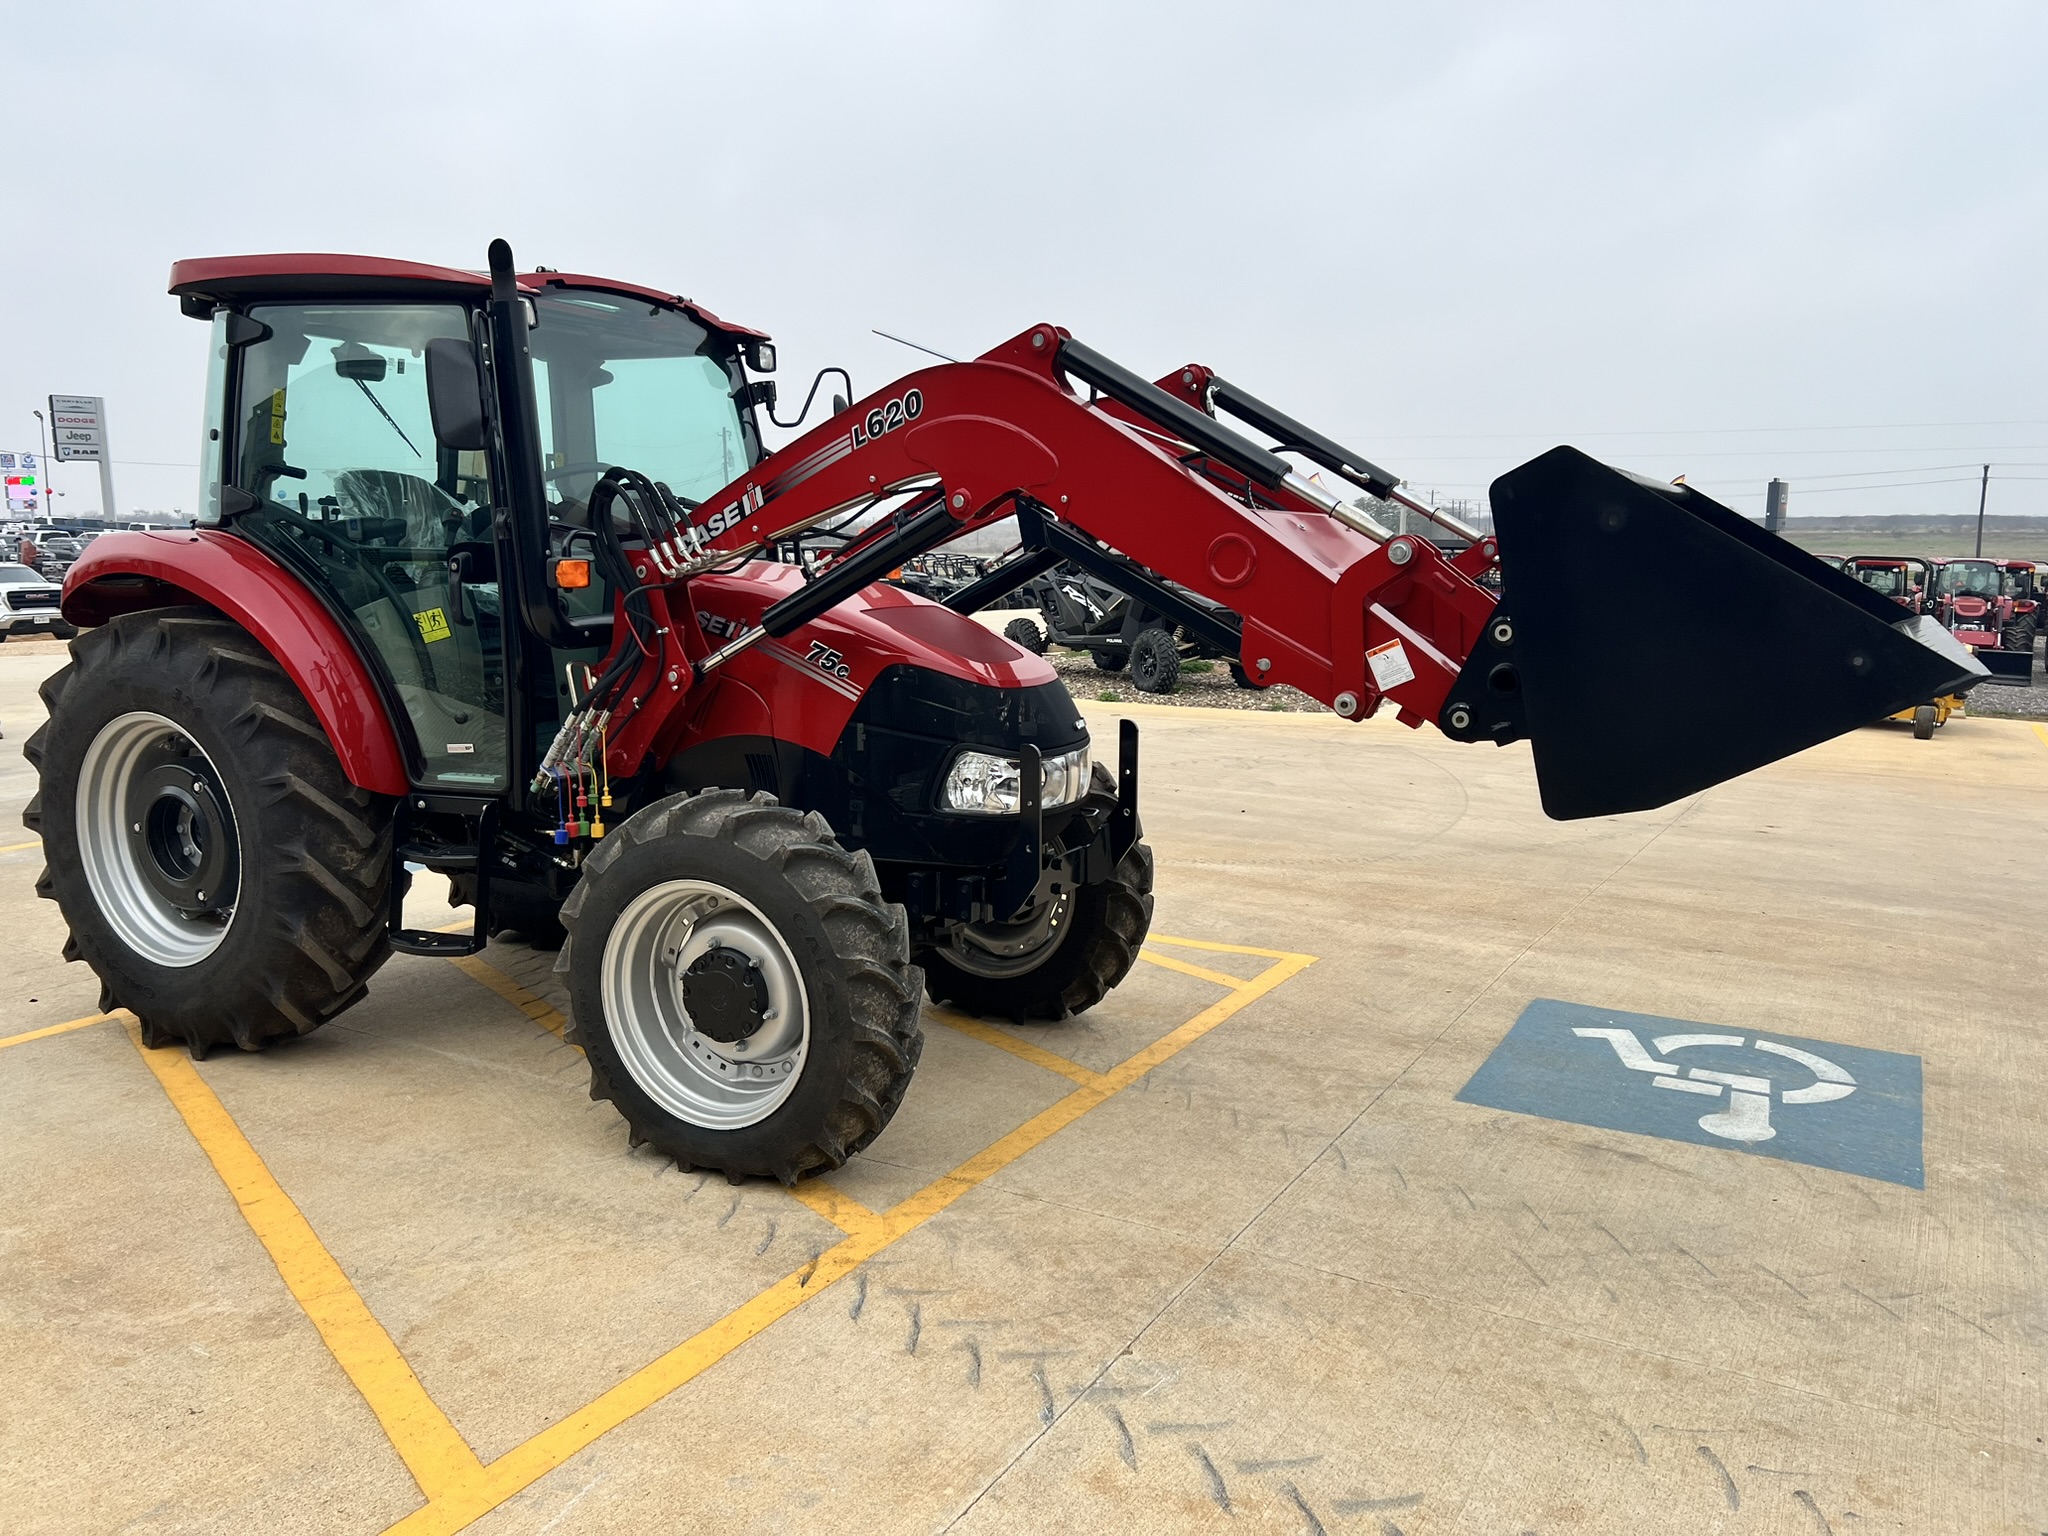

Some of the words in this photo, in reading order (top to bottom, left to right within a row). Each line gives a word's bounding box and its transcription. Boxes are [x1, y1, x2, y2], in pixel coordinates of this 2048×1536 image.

[66, 430, 91, 442] Jeep
[851, 388, 923, 449] L620
[1061, 585, 1105, 620] RZR
